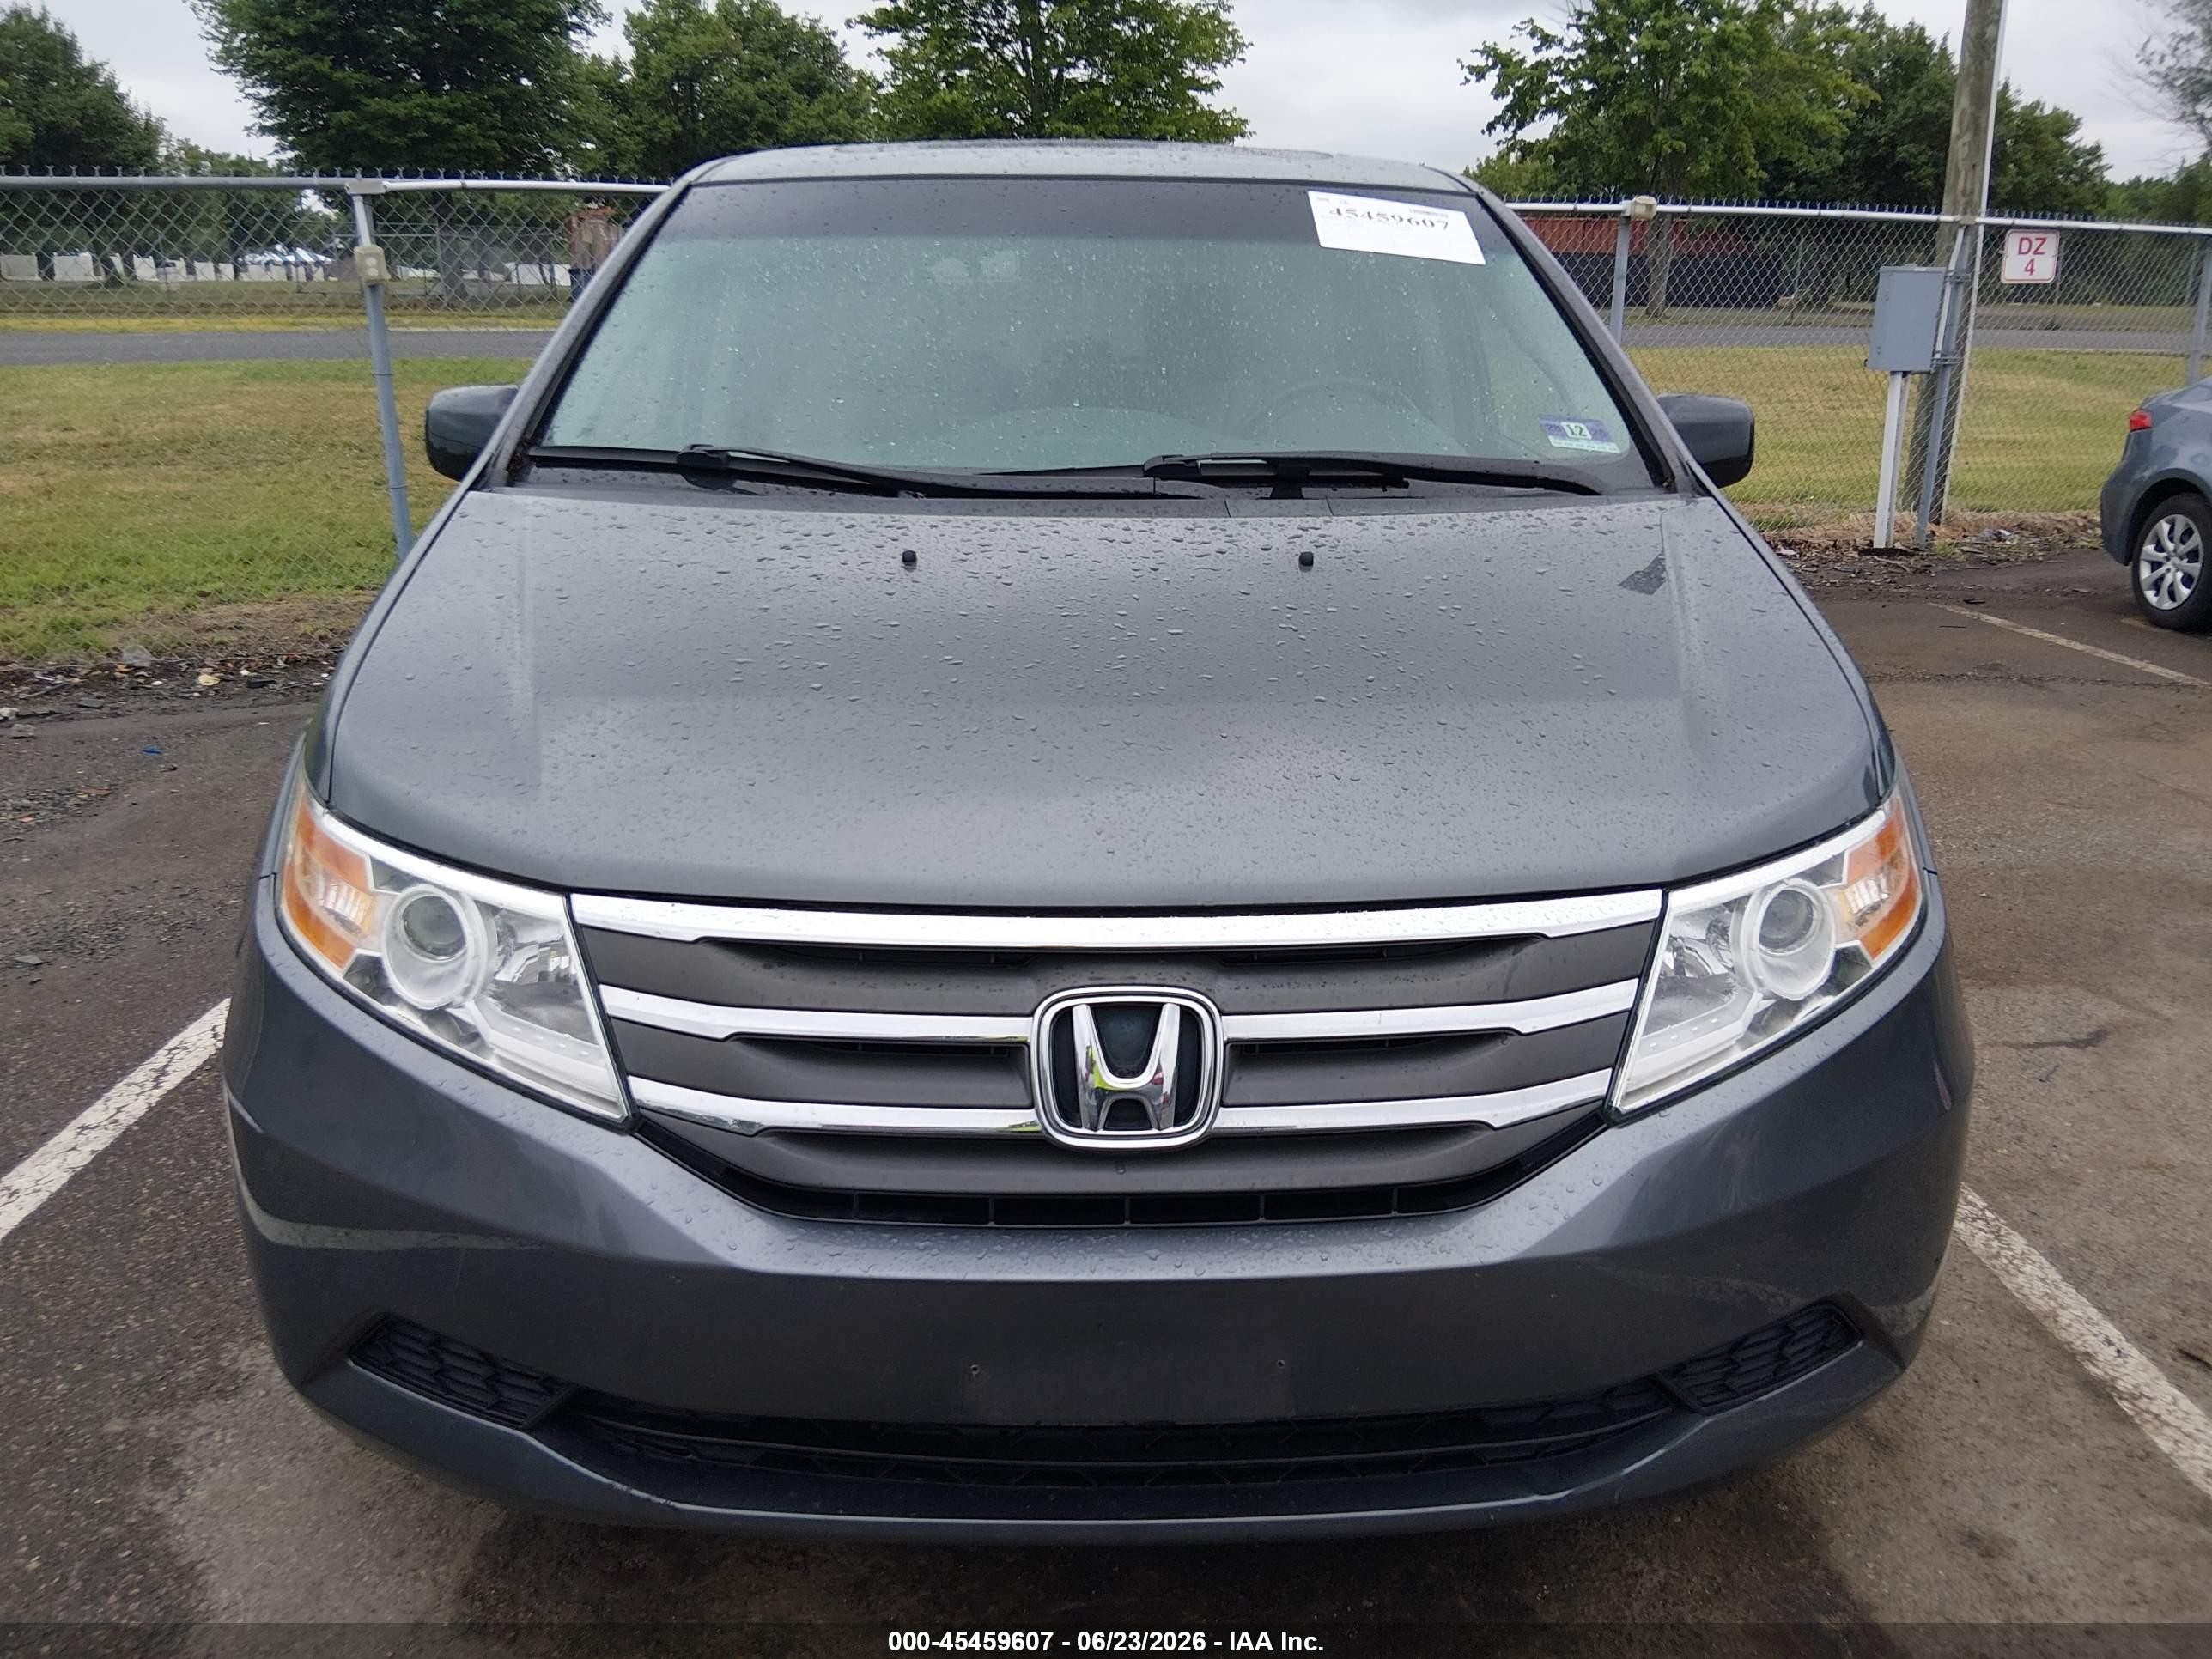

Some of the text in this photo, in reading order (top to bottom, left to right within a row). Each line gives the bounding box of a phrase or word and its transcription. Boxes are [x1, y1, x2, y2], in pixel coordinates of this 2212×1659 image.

[1329, 207, 1449, 230] 45459607
[2018, 237, 2047, 255] DZ
[2024, 258, 2035, 276] 4
[1566, 424, 1587, 437] 12
